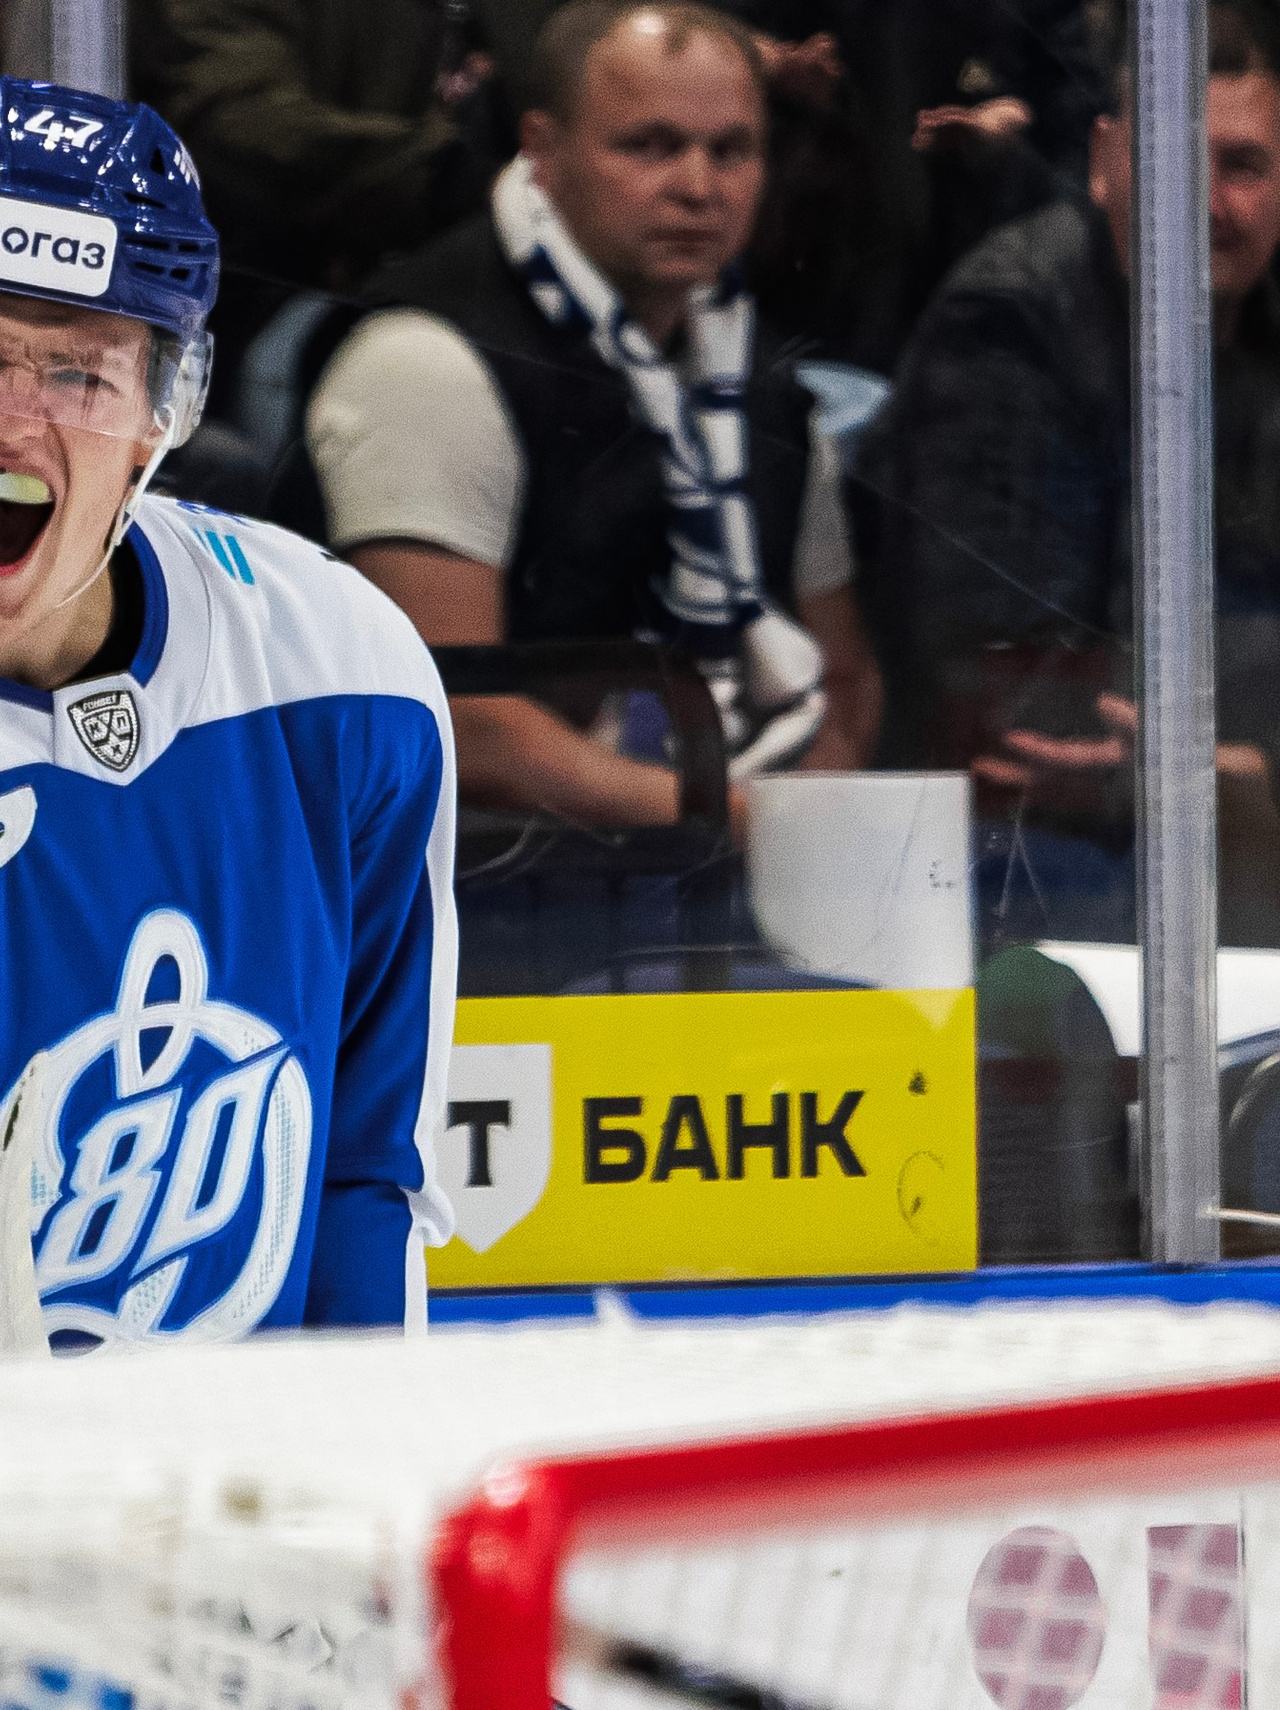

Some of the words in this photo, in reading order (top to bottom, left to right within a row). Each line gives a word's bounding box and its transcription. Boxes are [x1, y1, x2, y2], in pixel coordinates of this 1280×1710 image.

[24, 109, 104, 149] 47
[36, 1044, 288, 1302] 80
[581, 1089, 867, 1185] БАНК
